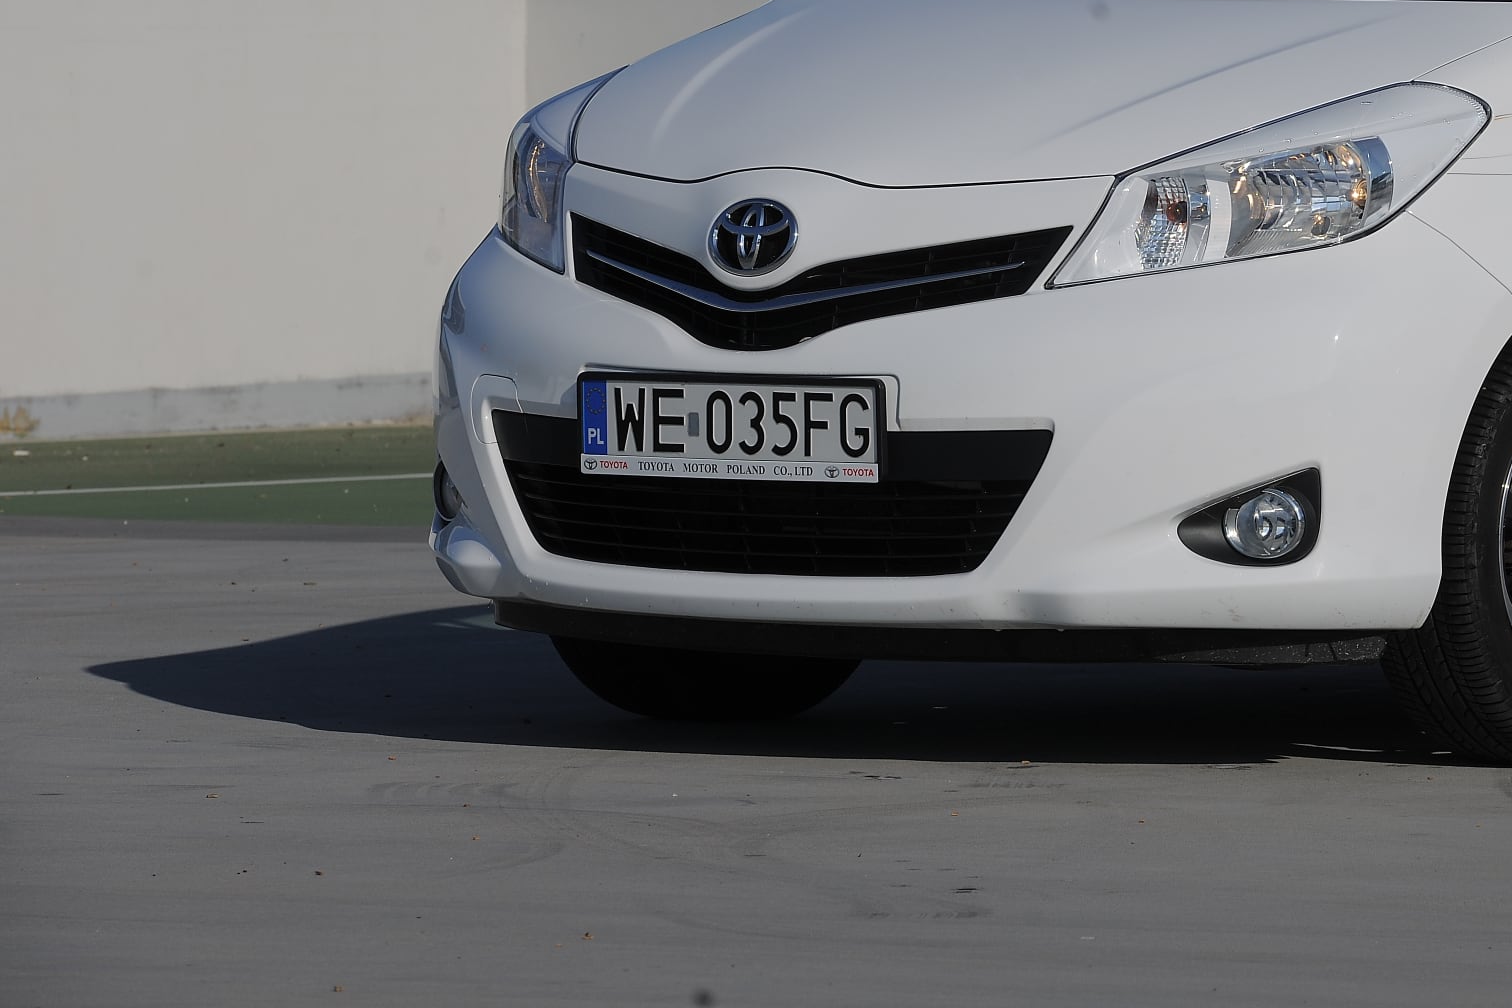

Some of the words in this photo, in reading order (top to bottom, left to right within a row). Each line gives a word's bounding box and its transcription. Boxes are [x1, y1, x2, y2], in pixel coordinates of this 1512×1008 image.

[614, 387, 686, 453] WE
[706, 390, 870, 458] 035FG
[588, 428, 604, 445] PL
[599, 461, 628, 469] TOYOTA
[638, 461, 674, 472] TOYOTA
[683, 463, 718, 473] MOTOR
[726, 465, 765, 475] POLAND
[842, 468, 874, 477] TOYOTA
